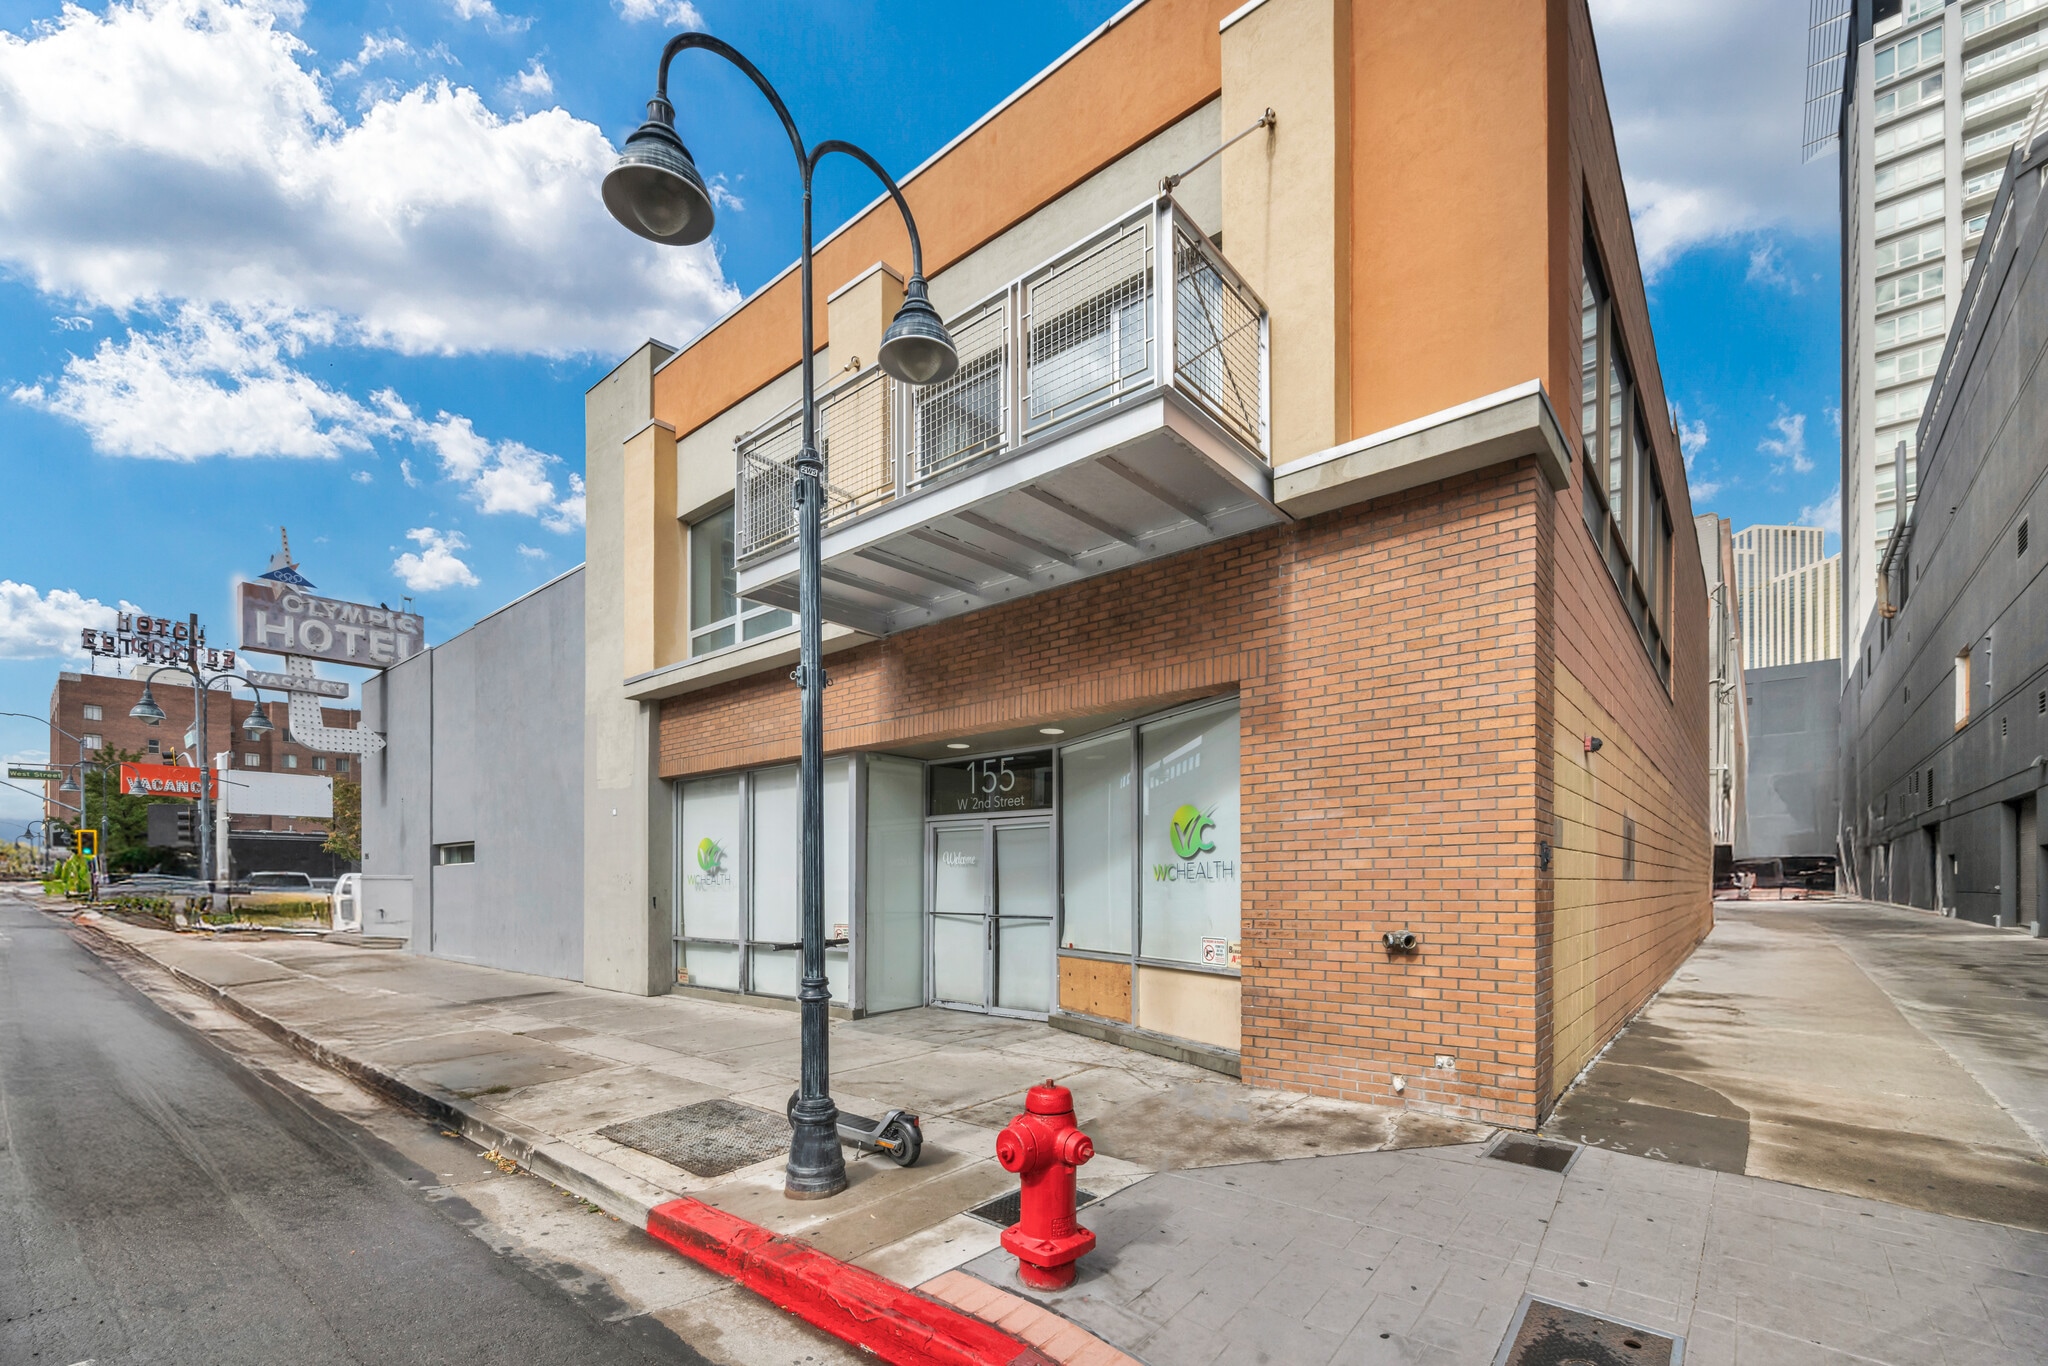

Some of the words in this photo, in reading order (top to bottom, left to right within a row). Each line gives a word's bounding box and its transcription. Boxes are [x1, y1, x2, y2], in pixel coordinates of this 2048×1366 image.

[282, 594, 418, 635] OLYMPIC
[118, 611, 206, 642] HOTEL
[252, 672, 345, 696] VACANCY
[9, 770, 30, 778] West
[34, 771, 62, 779] Street
[967, 757, 1015, 794] 155
[957, 799, 968, 811] W
[972, 797, 991, 810] 2nd
[994, 795, 1025, 808] Street
[942, 851, 976, 865] Welcome
[1153, 860, 1234, 881] WCHEALTH
